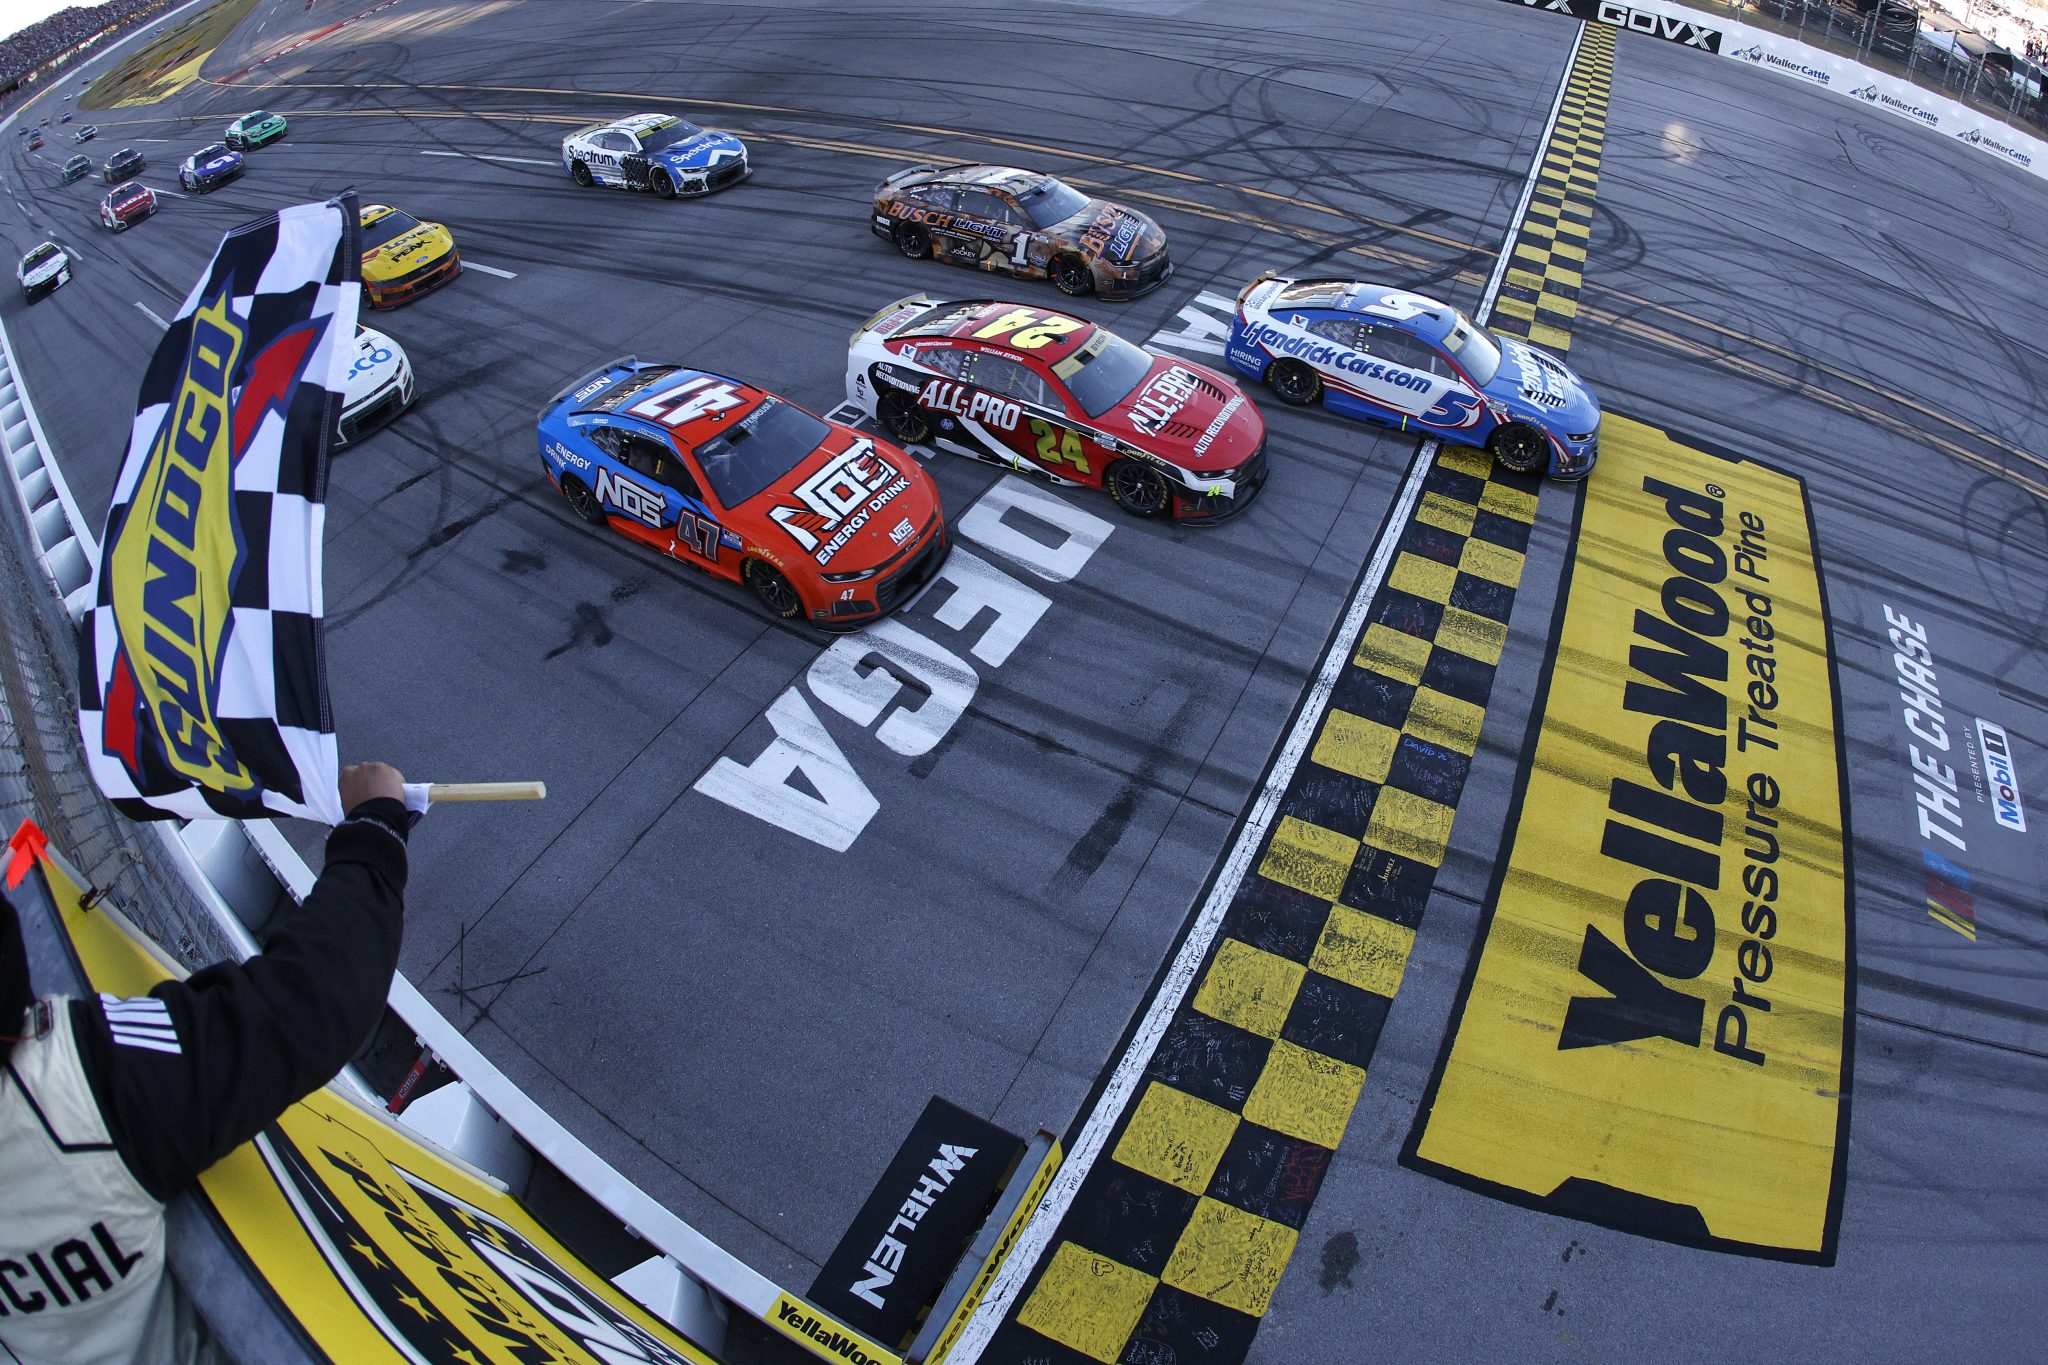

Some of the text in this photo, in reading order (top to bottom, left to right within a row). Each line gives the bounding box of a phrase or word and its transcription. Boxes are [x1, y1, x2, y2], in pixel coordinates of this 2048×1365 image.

[1597, 2, 1714, 51] GOVX
[568, 145, 616, 167] Spectrum
[887, 201, 954, 228] BUSCH
[953, 218, 1007, 239] LIGHT
[950, 249, 976, 259] JOCKEY
[1011, 232, 1030, 265] 1
[970, 308, 1085, 349] 24
[877, 362, 892, 374] AUTO
[980, 346, 1025, 362] WILLIAM BYRON
[1229, 355, 1260, 372] TECHNICIANS
[1230, 347, 1261, 366] HIRING
[1241, 320, 1432, 394] HendrickCars.com
[629, 376, 744, 428] 47
[875, 370, 921, 395] RECONDITIONING
[917, 379, 1022, 431] ALL-PRO
[1127, 365, 1199, 438] ALL-PRO
[740, 402, 773, 429] STENHOUSE
[1193, 394, 1246, 457] AUTO RECONDITIONING
[1418, 389, 1482, 429] 5
[545, 443, 567, 471] DRINK
[555, 442, 592, 471] ENERGY
[1029, 418, 1091, 475] 24
[595, 467, 668, 529] NOS
[767, 436, 900, 553] NOS
[1207, 485, 1221, 497] 24
[678, 511, 720, 561] 47
[815, 475, 912, 567] ENERGY DRINK
[888, 517, 915, 545] NOS
[143, 313, 243, 778] SUNOCO
[746, 546, 785, 568] GOODYEAR
[840, 588, 855, 601] 47
[1882, 603, 1967, 852] THE CHASE
[1963, 725, 1985, 803] PRESENTED BY
[1714, 510, 1781, 1067] Pressure Treated Pine
[1989, 756, 2020, 825] Mobil
[848, 1142, 980, 1311] WHELEN
[931, 1162, 1053, 1365] YellaWood
